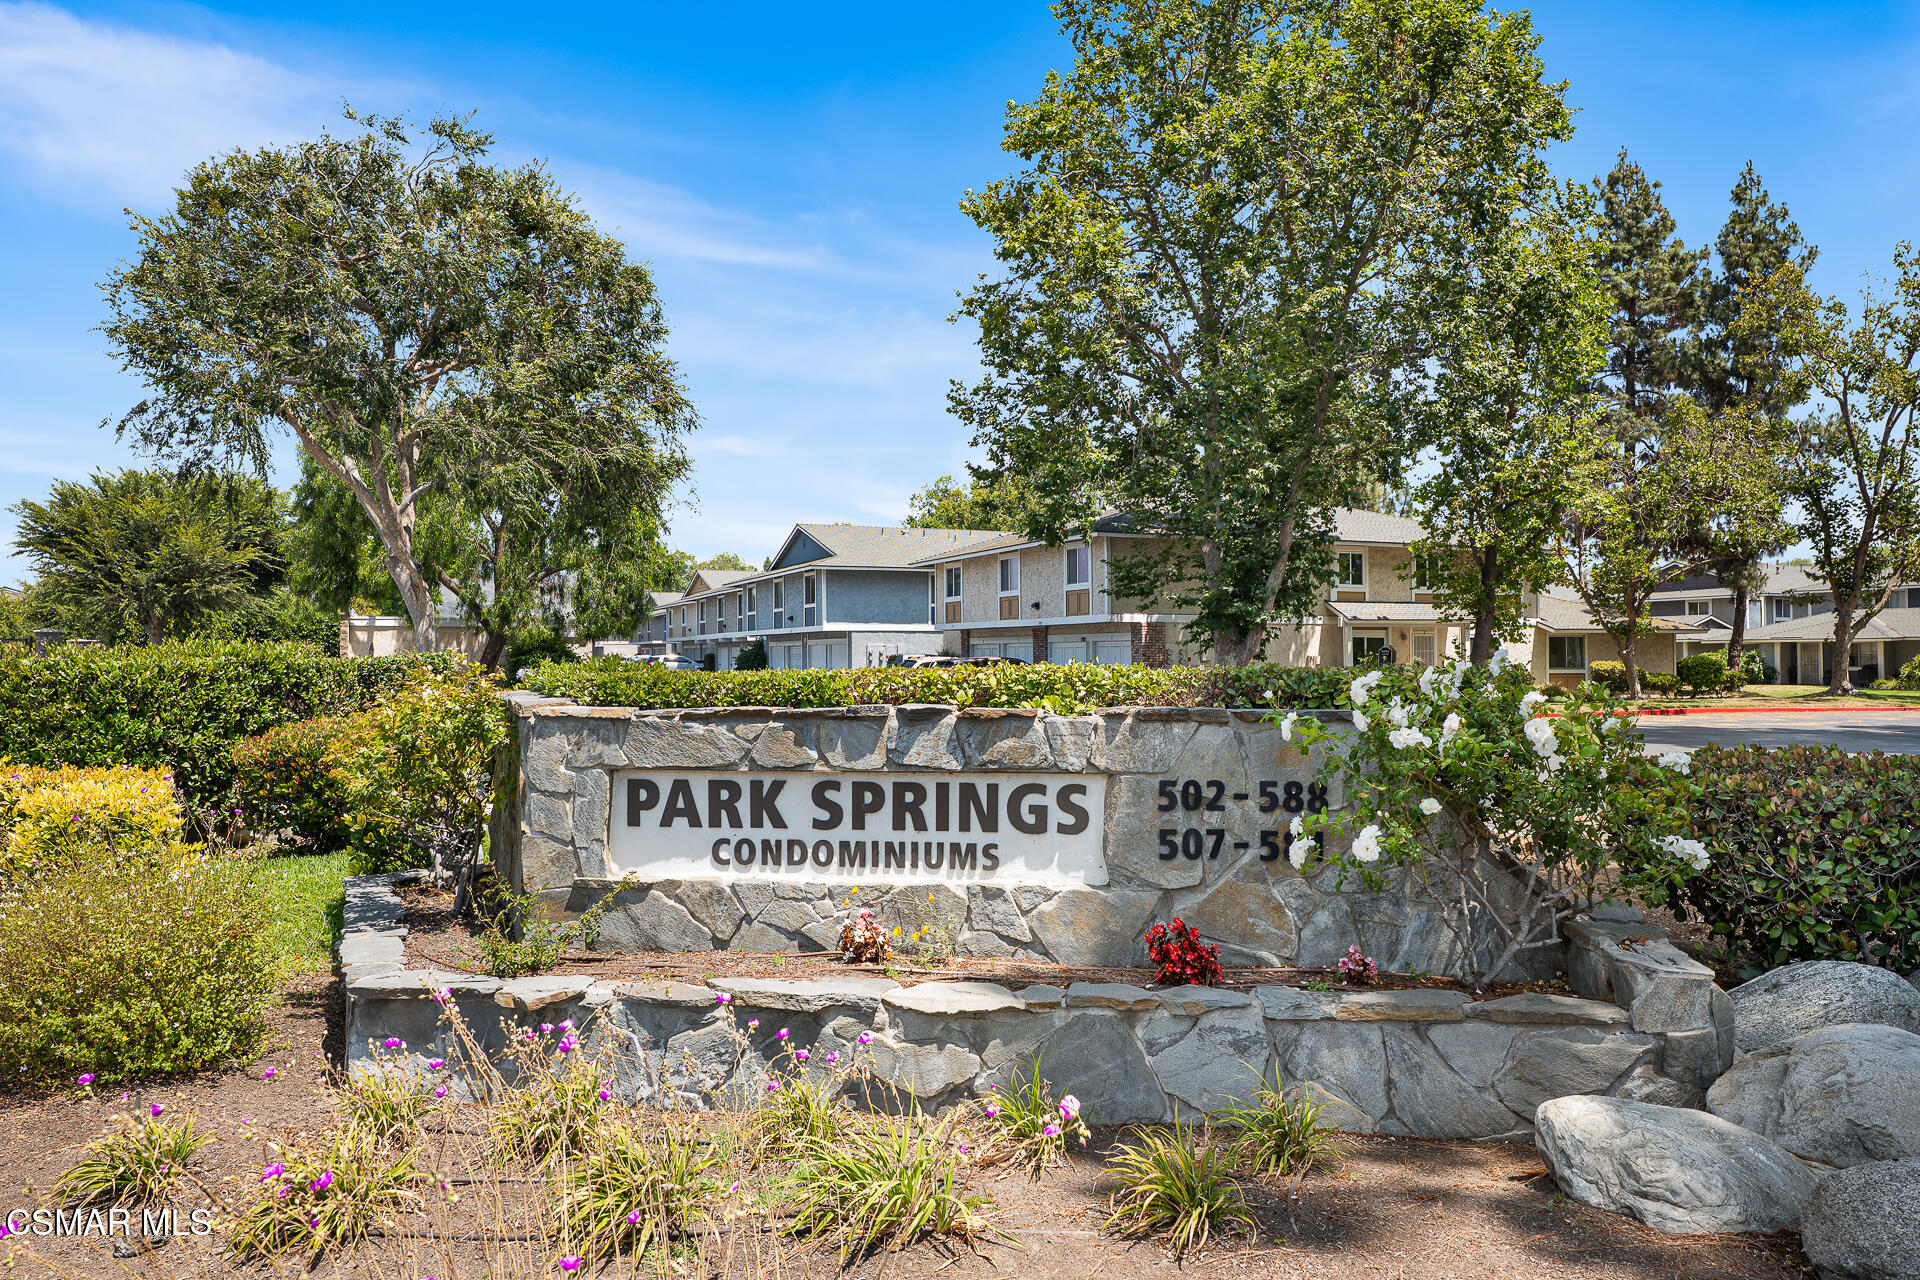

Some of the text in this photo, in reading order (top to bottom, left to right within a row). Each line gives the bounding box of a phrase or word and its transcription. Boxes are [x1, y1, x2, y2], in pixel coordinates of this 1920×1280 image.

[627, 779, 1090, 834] PARK SPRINGS
[1159, 779, 1330, 813] 502-588
[711, 837, 1000, 871] CONDOMINIUMS
